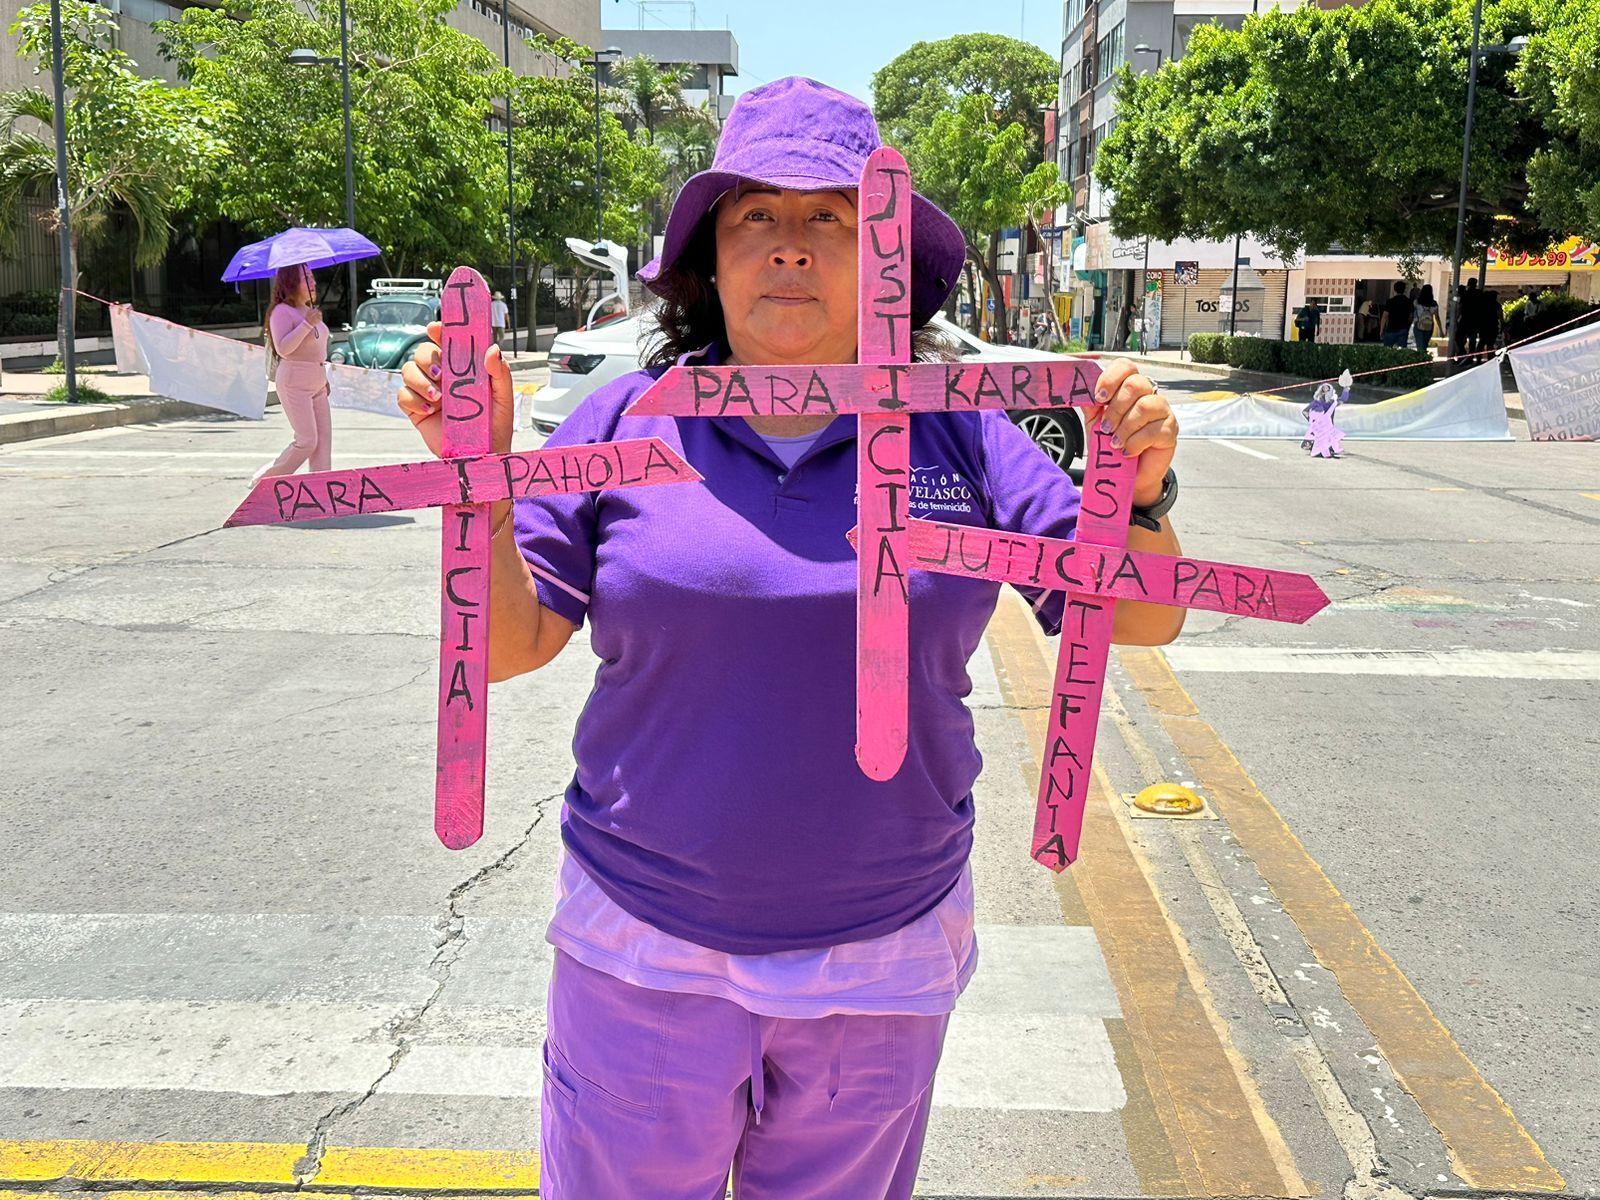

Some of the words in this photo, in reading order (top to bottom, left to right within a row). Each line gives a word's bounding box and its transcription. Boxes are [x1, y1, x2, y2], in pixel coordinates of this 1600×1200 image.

[688, 367, 838, 416] PARA
[944, 364, 1096, 408] KARLA
[862, 168, 910, 604] JUSTICIA
[273, 475, 394, 519] PARA
[501, 442, 678, 499] PAHOLA
[445, 278, 484, 711] JUSTICIA
[910, 473, 960, 486] ACIÓN
[918, 500, 929, 510] de
[917, 525, 1149, 596] JUTICIA
[1174, 561, 1278, 618] PARA
